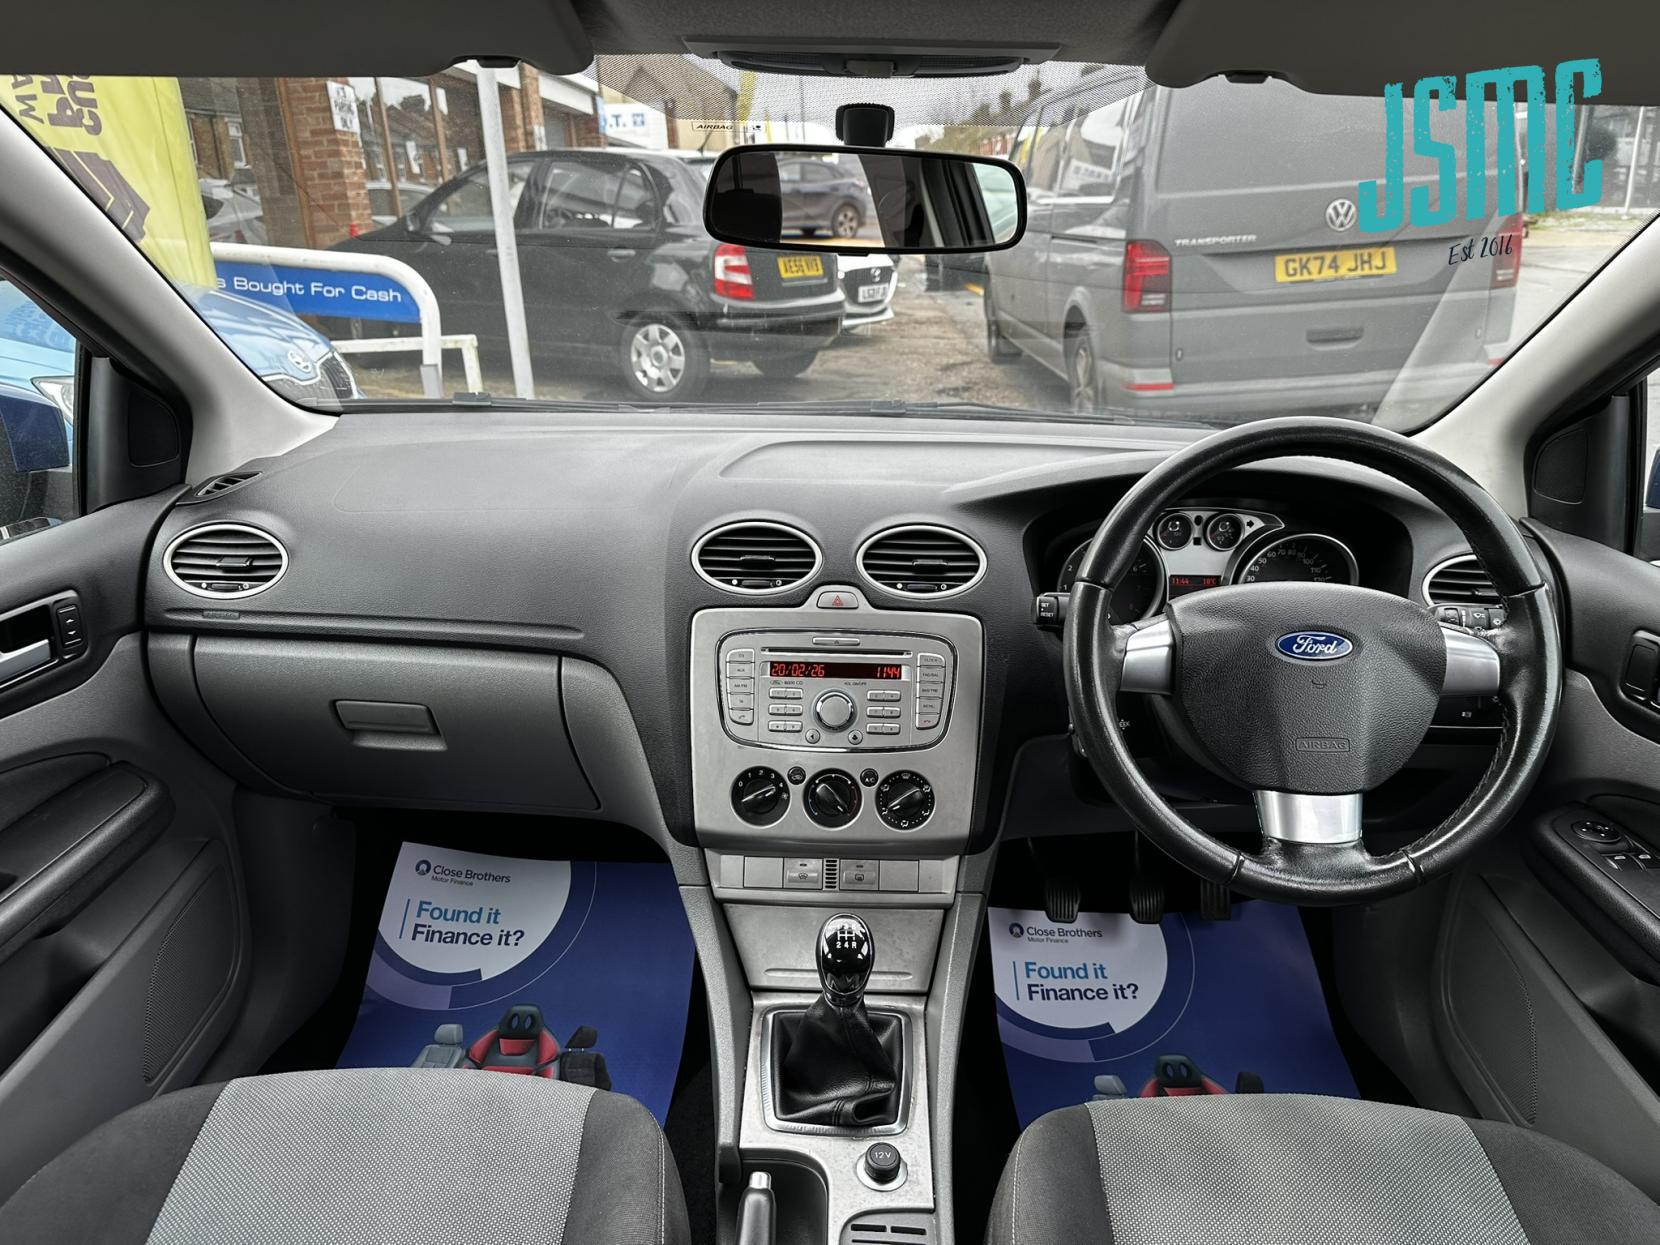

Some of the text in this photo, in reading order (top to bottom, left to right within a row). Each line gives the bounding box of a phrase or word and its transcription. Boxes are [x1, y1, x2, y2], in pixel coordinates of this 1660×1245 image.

[1174, 234, 1257, 247] TRANSPORTER
[1284, 252, 1387, 278] GK74 JHJ
[233, 276, 304, 296] Bought
[310, 282, 345, 297] For
[351, 285, 402, 302] Cash
[1292, 635, 1338, 654] Ford
[771, 663, 825, 677] 20/02/26
[433, 864, 511, 884] Close Brothers
[450, 879, 474, 887] Finance
[416, 900, 501, 925] Found it
[411, 923, 525, 947] Finance it?
[1026, 926, 1103, 938] Close Brothers
[1024, 962, 1108, 980] Found it
[1027, 983, 1139, 1001] Finance it?
[875, 1151, 892, 1159] 12V
